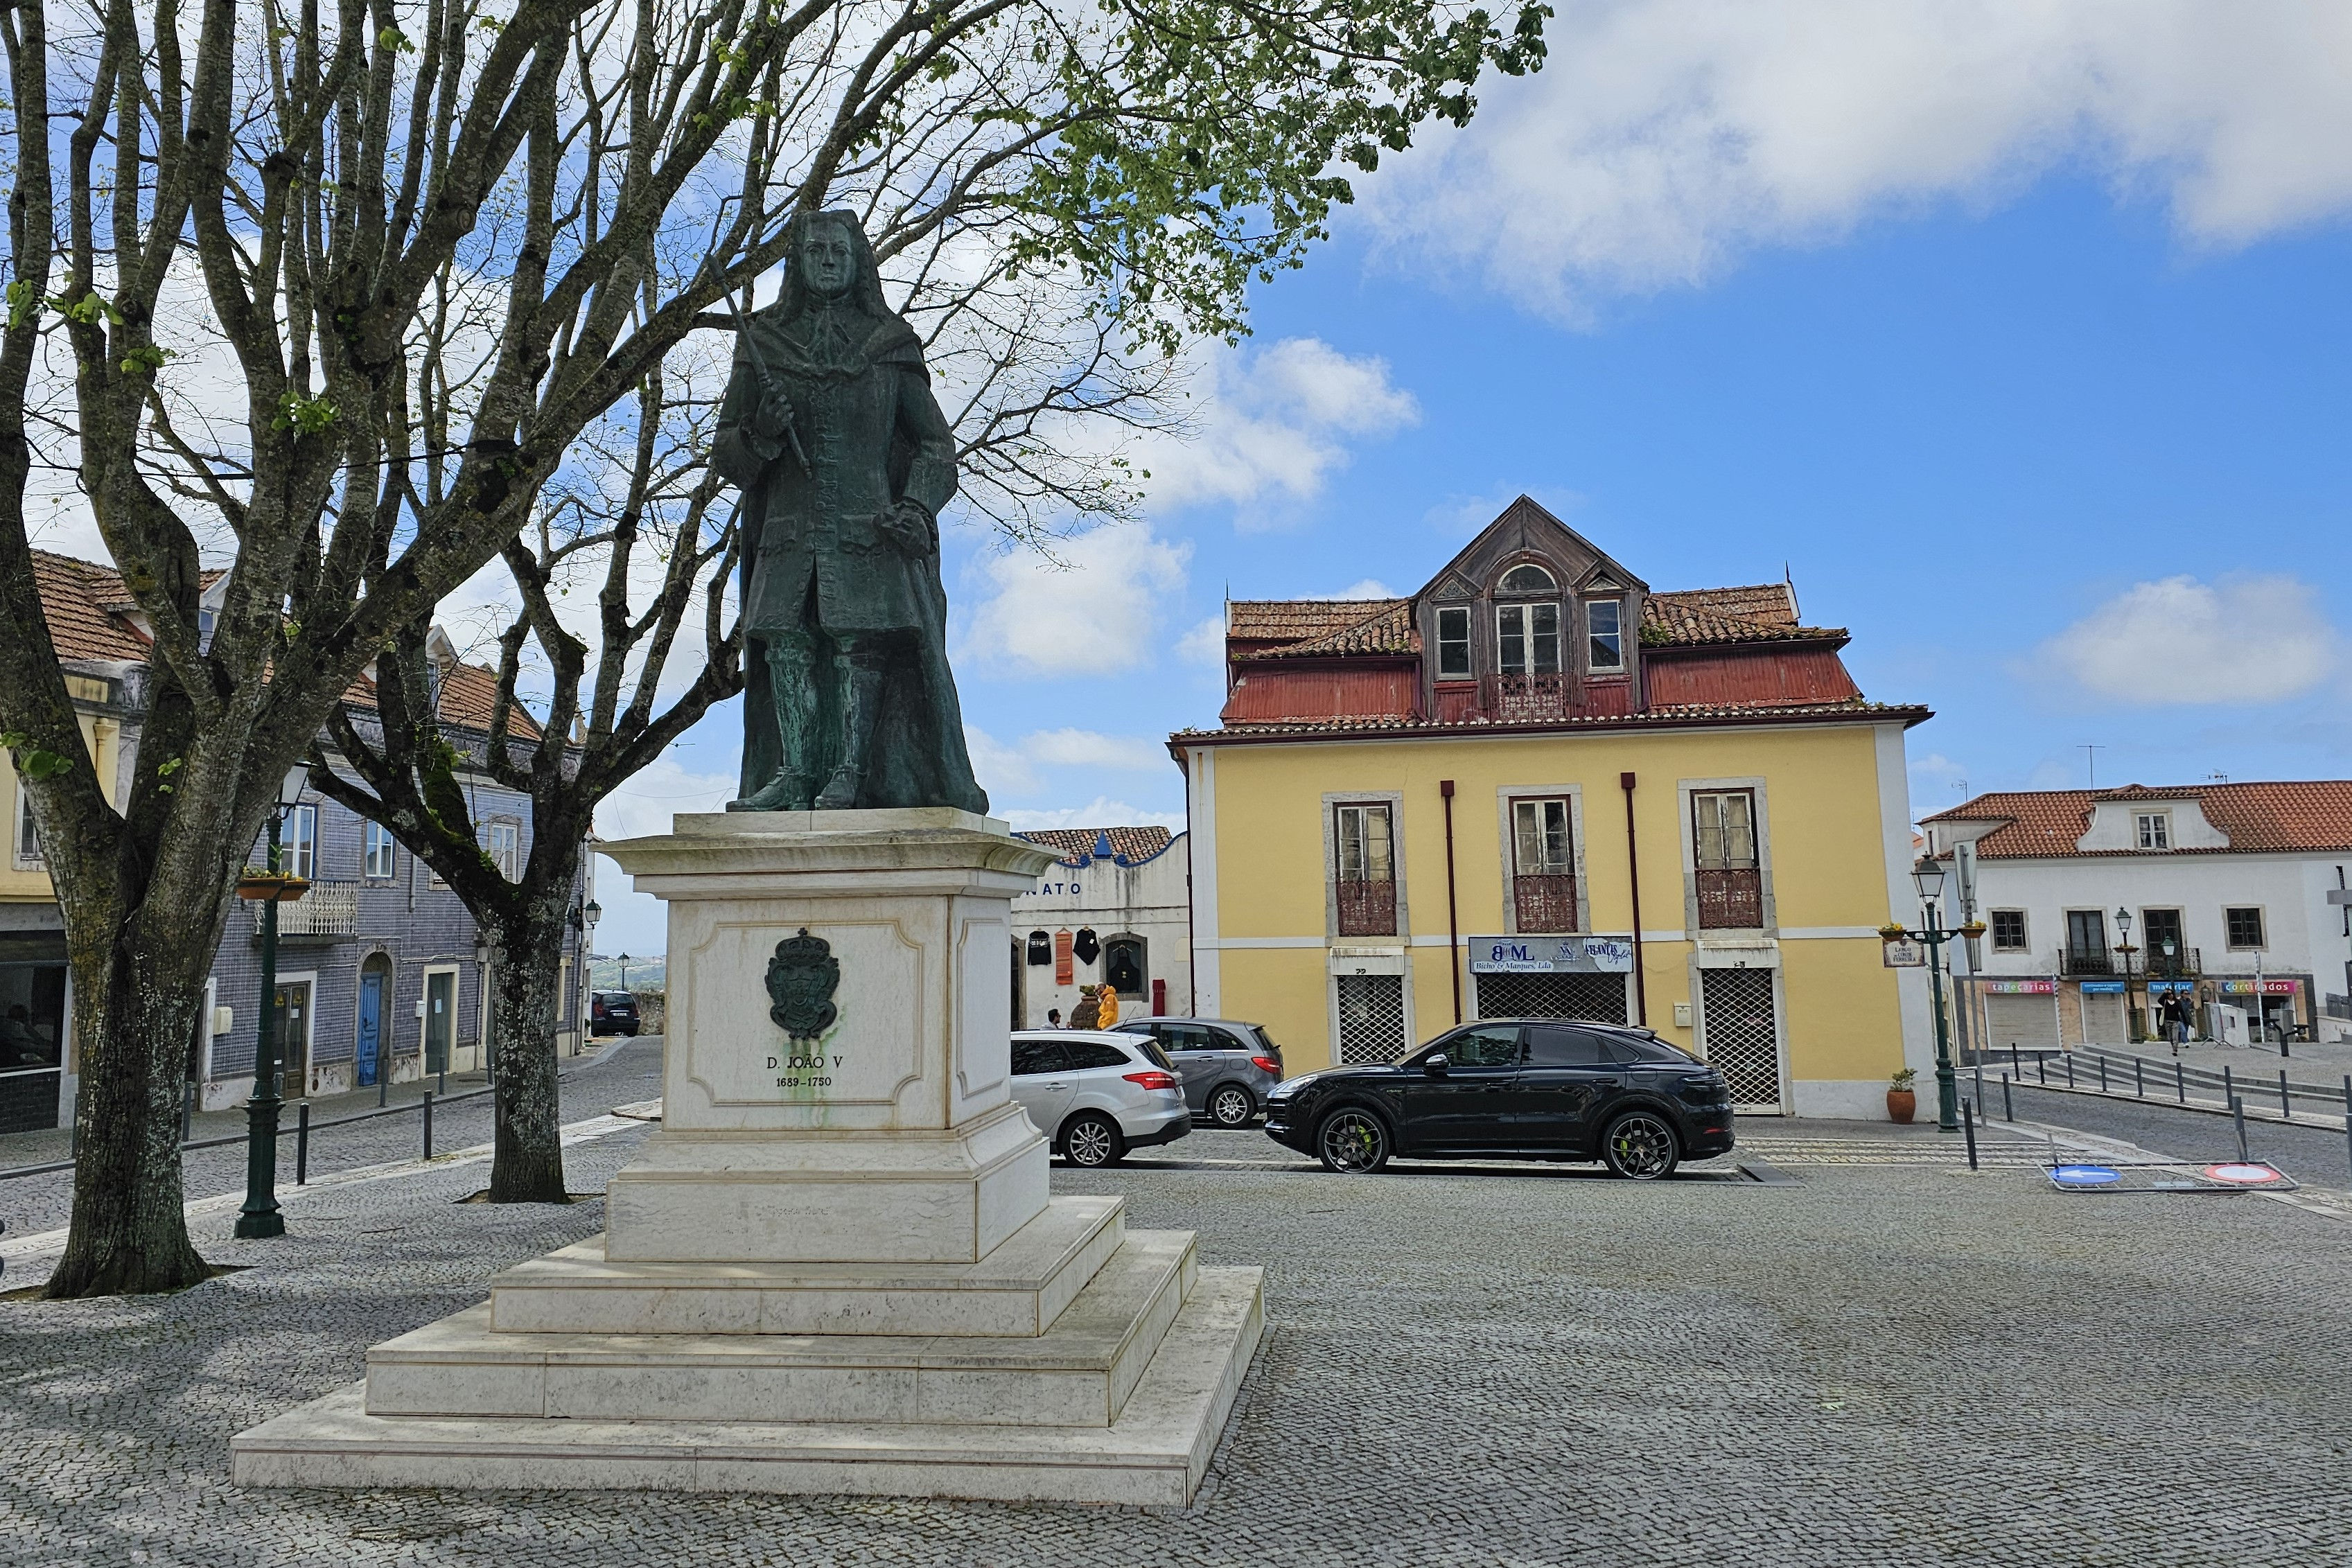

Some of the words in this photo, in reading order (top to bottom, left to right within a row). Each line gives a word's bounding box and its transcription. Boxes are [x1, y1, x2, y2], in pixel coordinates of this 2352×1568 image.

[1992, 983, 2051, 993] tapeçarias
[766, 1057, 780, 1069] D.
[787, 1053, 825, 1069] JOÃO
[833, 1056, 843, 1068] V
